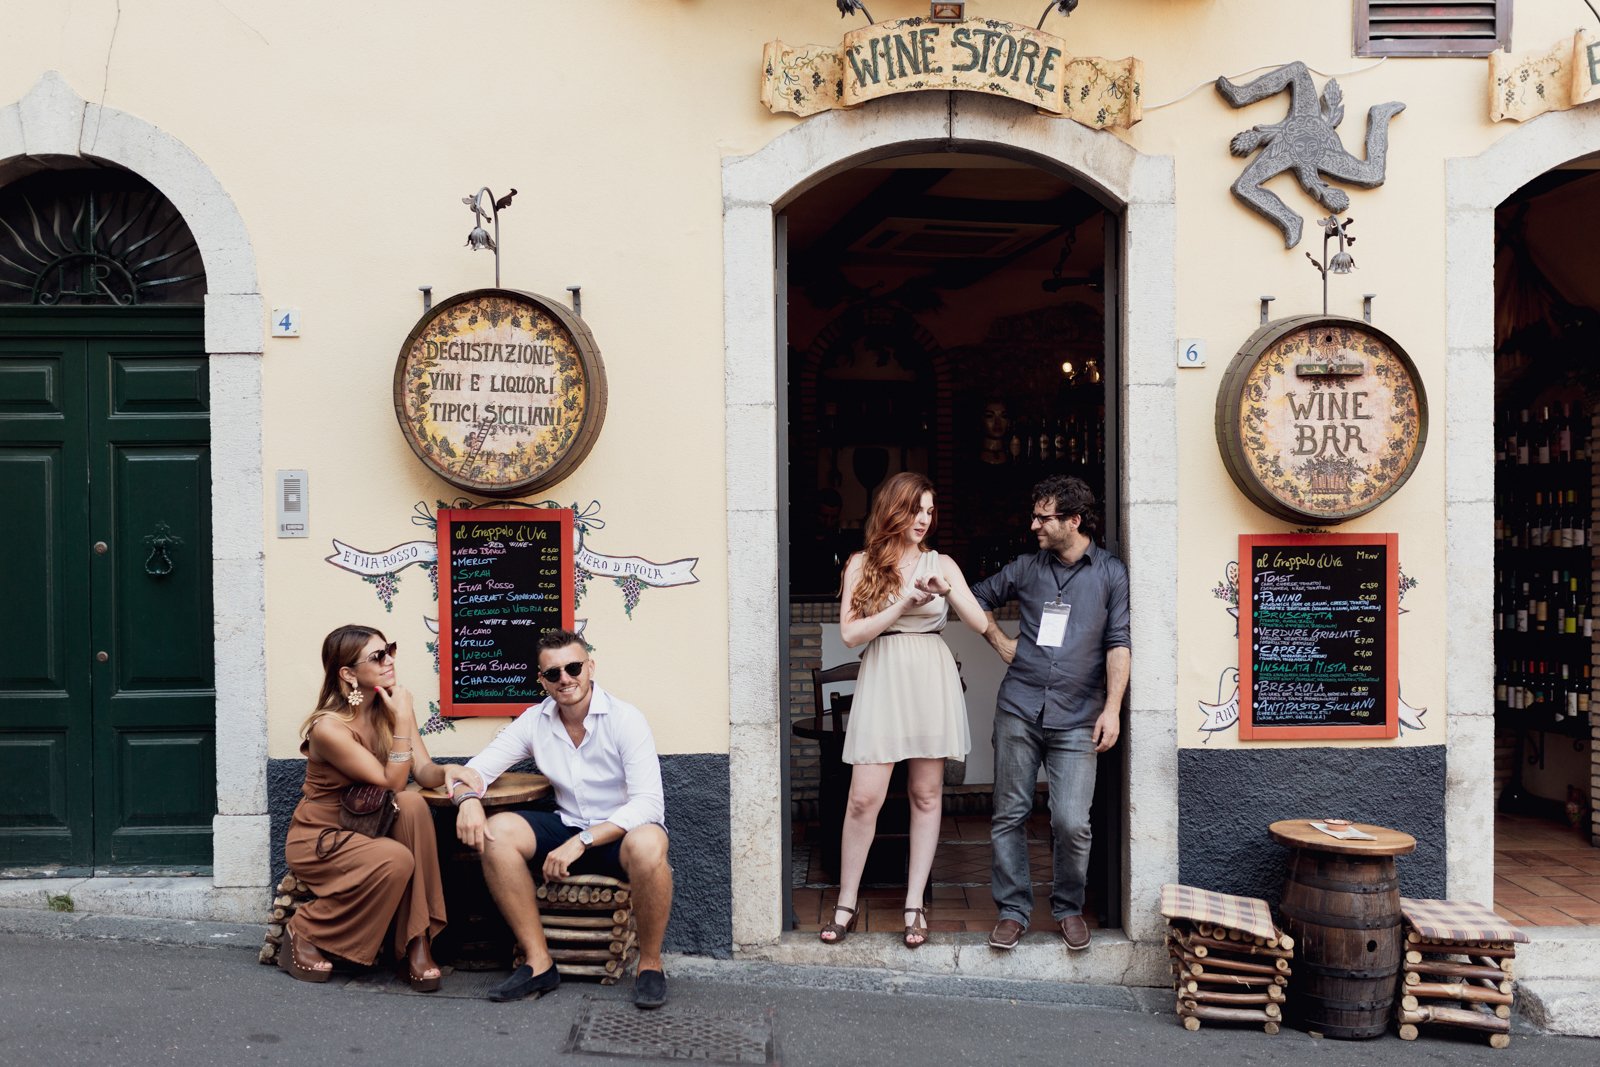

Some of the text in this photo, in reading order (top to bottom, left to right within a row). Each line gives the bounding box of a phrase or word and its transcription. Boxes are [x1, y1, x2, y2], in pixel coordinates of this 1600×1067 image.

[846, 27, 1062, 92] WINE STORE
[279, 313, 292, 331] 4
[424, 341, 555, 365] DEGUSTAZIONE
[1186, 343, 1198, 362] 6
[429, 371, 556, 395] VINI E LIQUORI
[1286, 391, 1371, 420] WINE
[430, 402, 562, 426] TIPICI SICILIANI
[1291, 422, 1368, 458] BAR
[456, 524, 547, 542] al Grappolo d'Uva
[343, 546, 418, 569] ETNA ROSSO
[457, 547, 478, 556] NERO
[457, 557, 498, 567] MERLOT
[579, 550, 608, 570] NERO
[1256, 553, 1269, 568] al
[1273, 551, 1315, 571] Grappolo
[458, 569, 491, 580] SYRAH
[1257, 570, 1295, 583] TOAST
[458, 582, 482, 593] ETNA
[486, 579, 515, 590] ROSSO
[458, 593, 505, 605] CABERNET
[1259, 591, 1302, 603] PANINO
[1258, 610, 1333, 620] BRUSCHETTA
[1258, 627, 1361, 640] VERDURE GRIGLIATE
[460, 636, 495, 647] GRILLO
[462, 649, 503, 660] INZOLIA
[1260, 645, 1321, 654] CAPRESE
[460, 659, 528, 672] ETNA BIANCO
[1259, 661, 1310, 673] INSALATA
[1315, 660, 1347, 673] MISTA
[460, 675, 527, 686] CHARDONNAY
[1258, 680, 1325, 693] BRESAOLA
[504, 685, 538, 697] BLANC
[1257, 699, 1321, 712] ANTIPASTO
